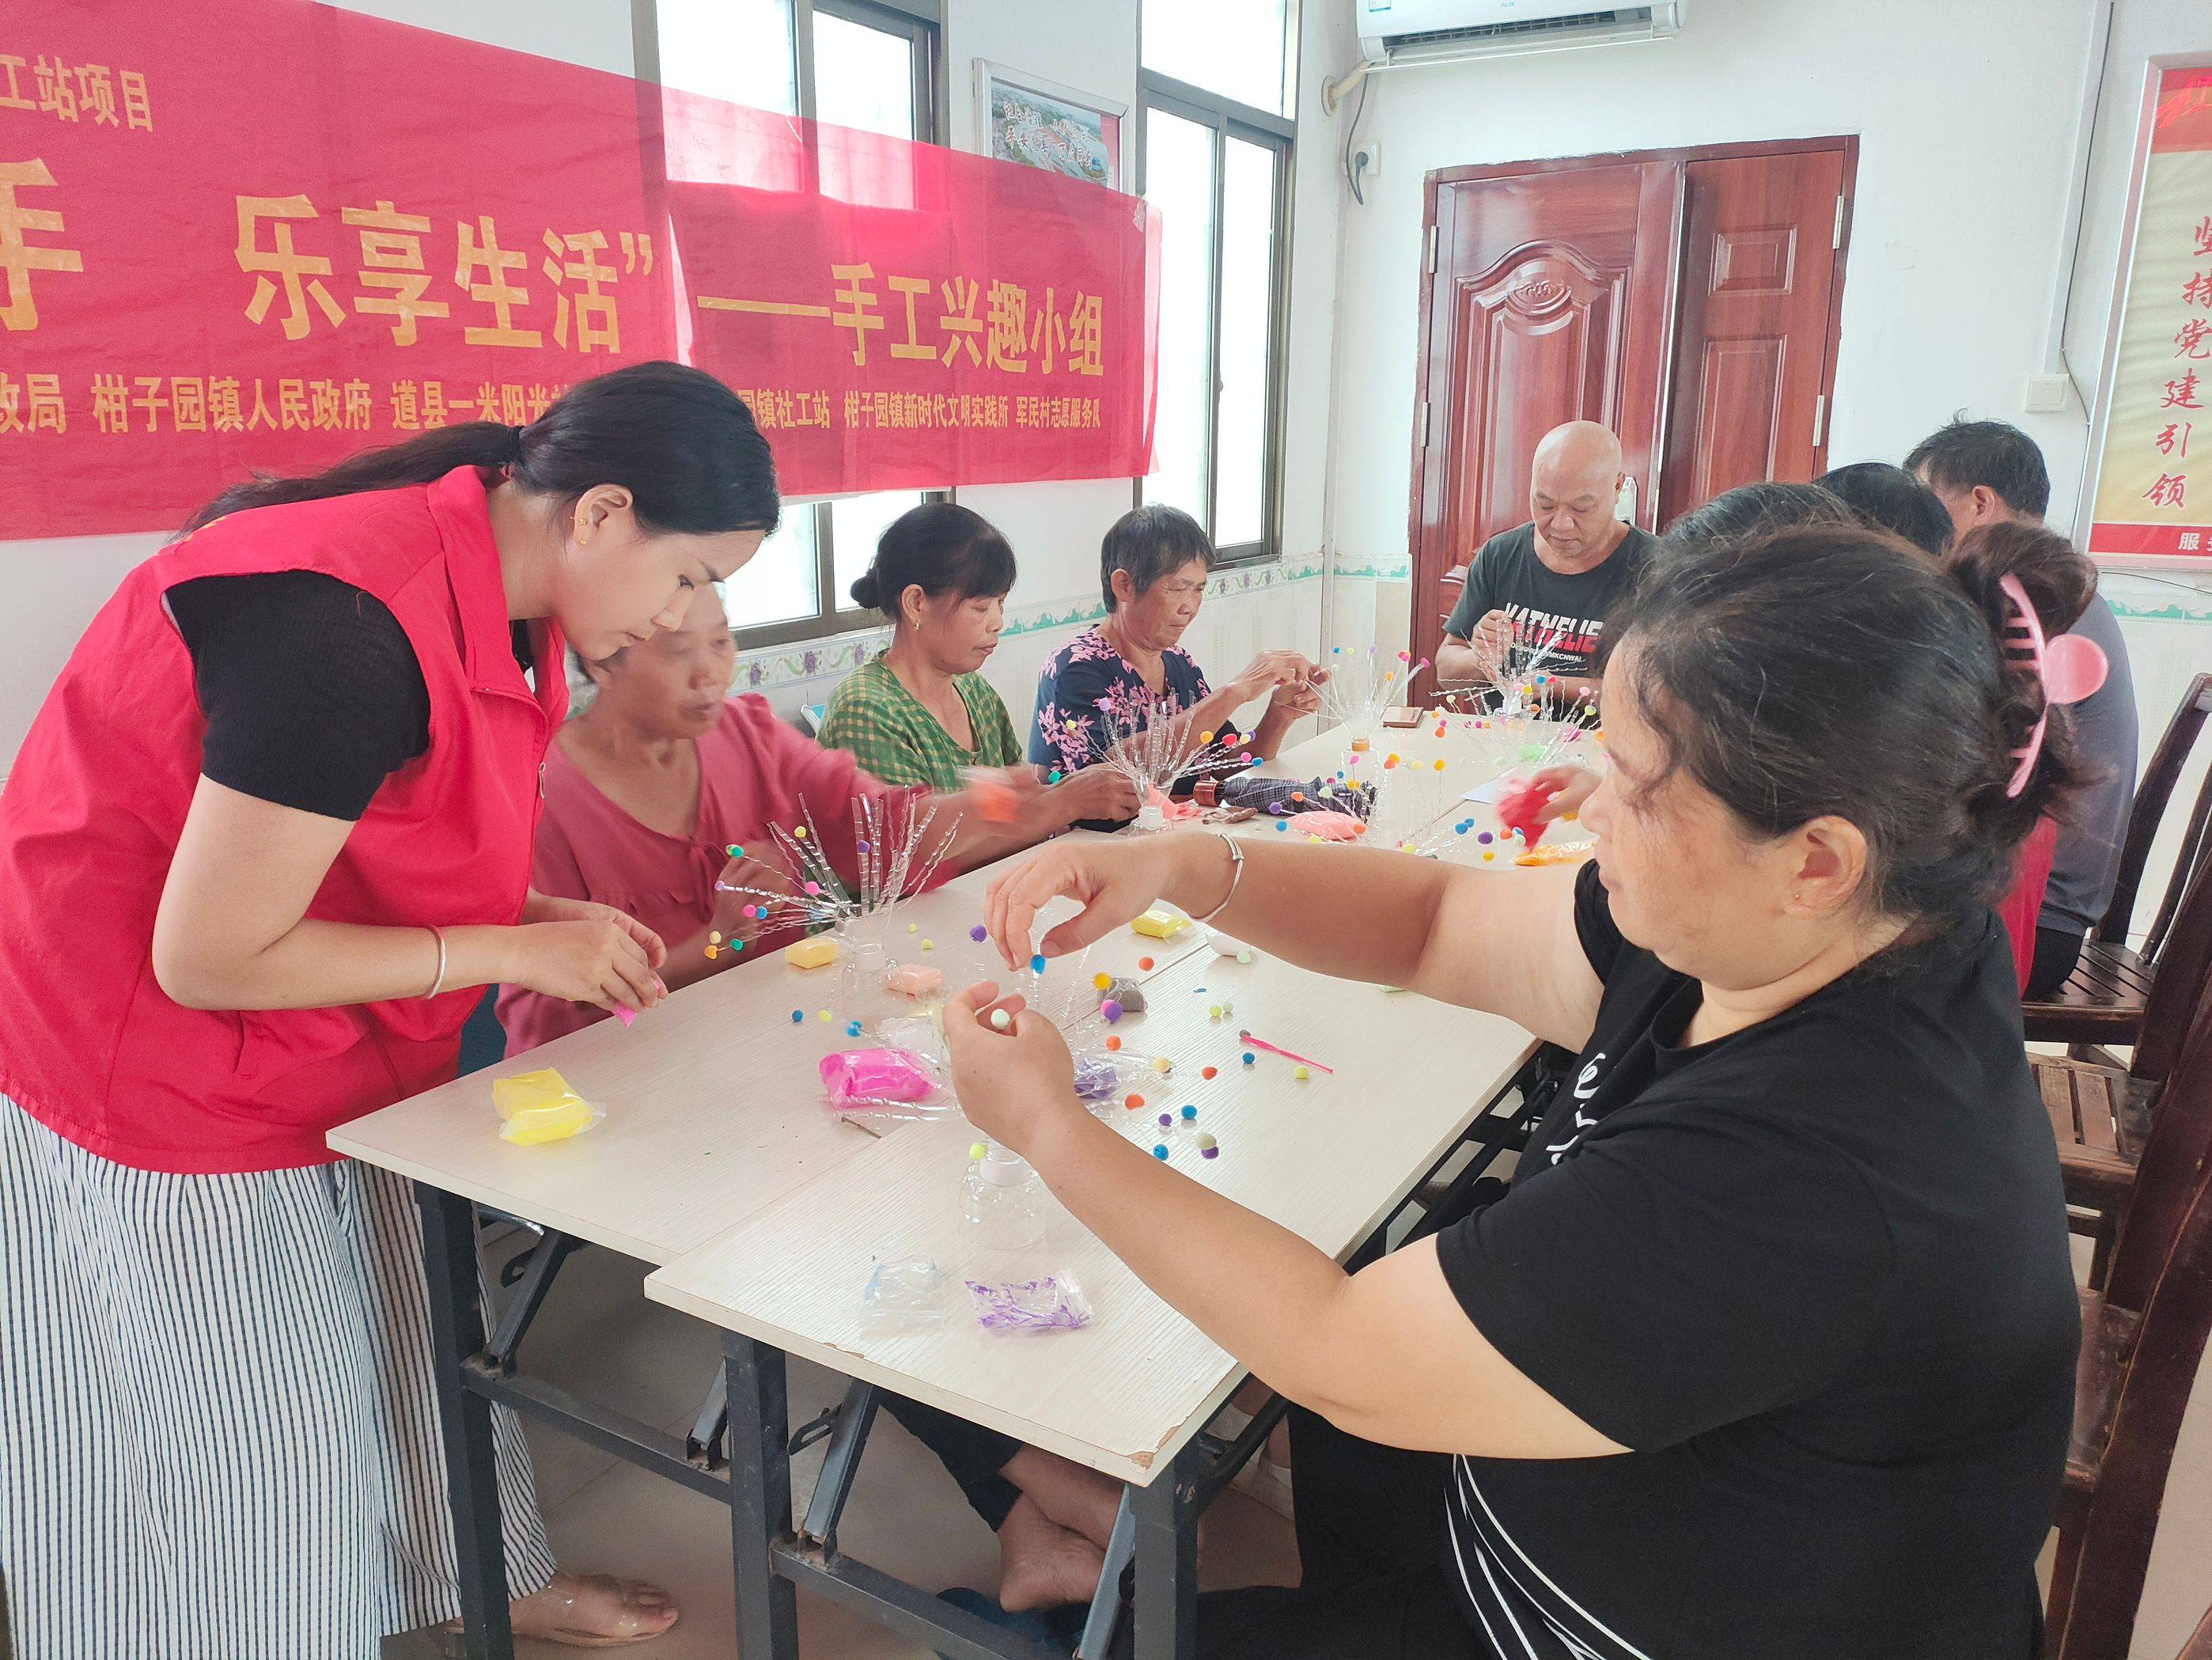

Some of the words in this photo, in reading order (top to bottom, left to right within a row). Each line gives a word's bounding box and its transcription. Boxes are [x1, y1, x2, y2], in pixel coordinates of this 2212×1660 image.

[0, 54, 153, 132] 工站项目
[90, 373, 373, 434] 柑子园镇人民政府
[390, 379, 570, 430] 道县一米阳光
[844, 390, 1009, 429] 柑子园镇新时代文明实践所
